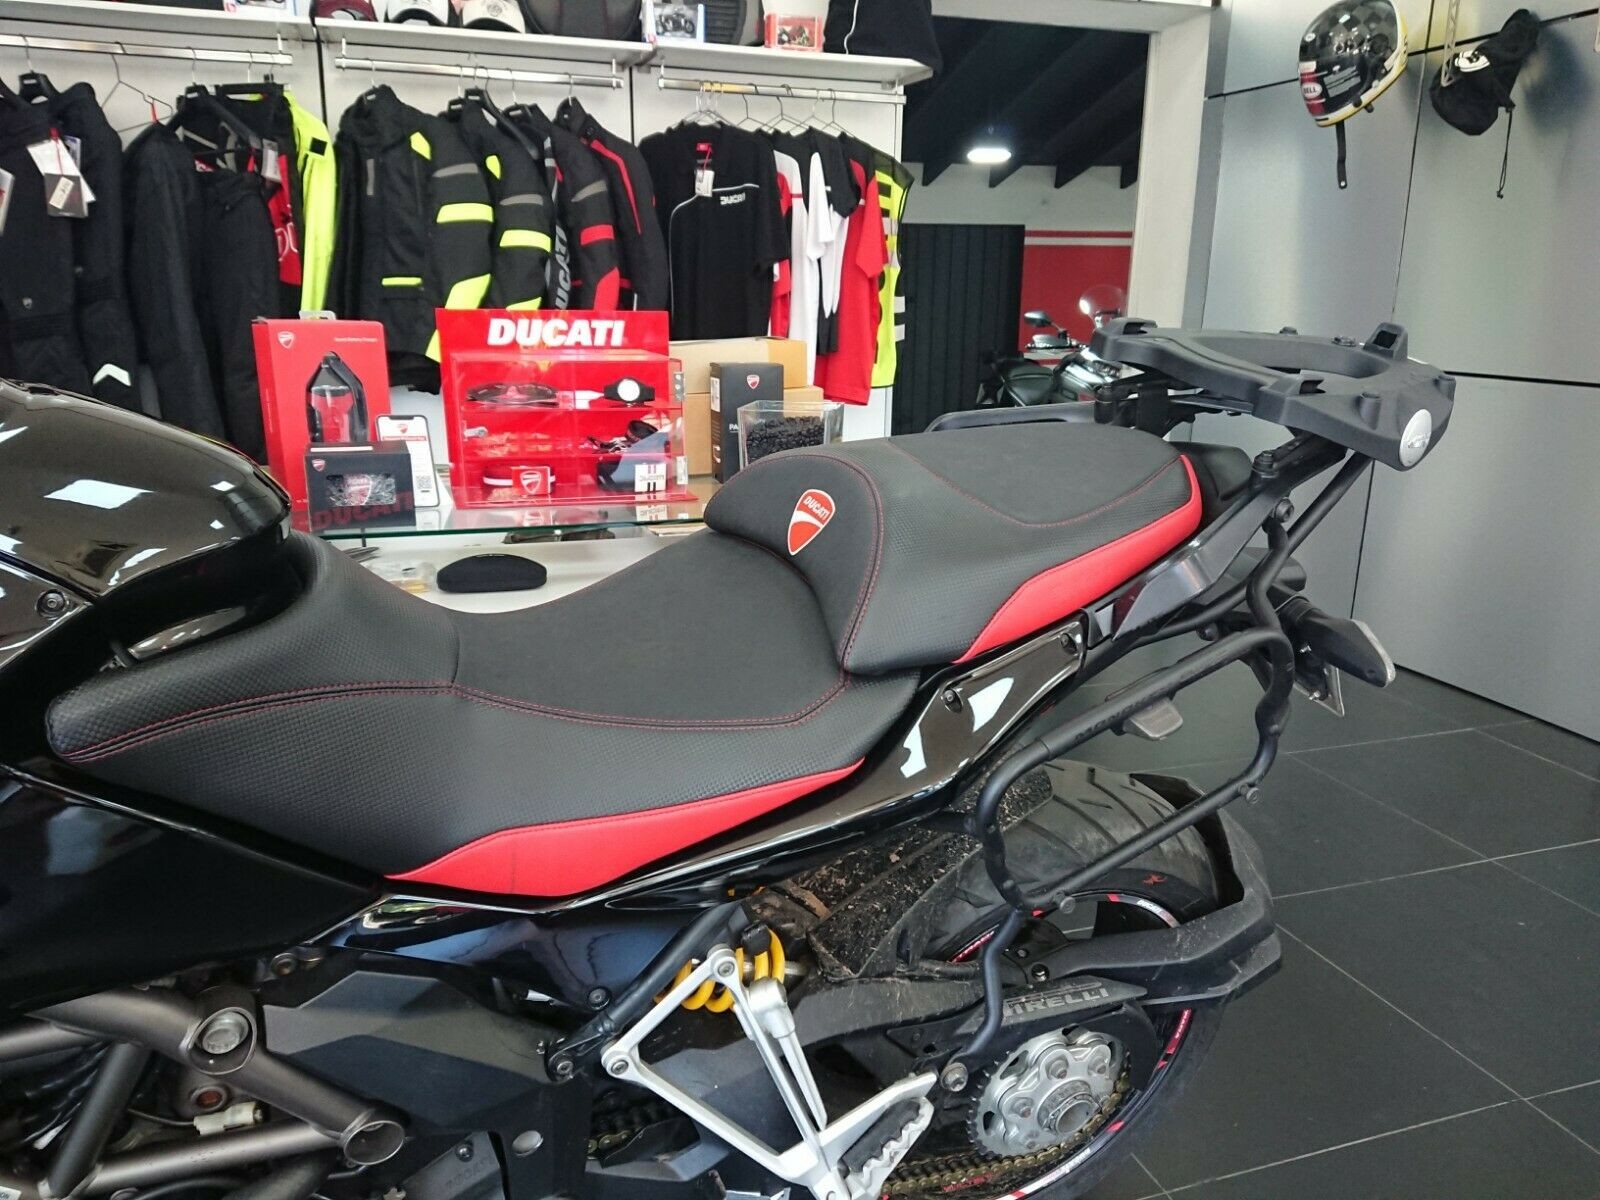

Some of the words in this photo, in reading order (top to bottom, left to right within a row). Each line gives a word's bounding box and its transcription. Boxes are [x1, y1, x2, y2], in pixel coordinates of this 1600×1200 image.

[555, 224, 571, 310] UCATI
[487, 317, 626, 347] DUCATI
[802, 495, 831, 521] DUCATI
